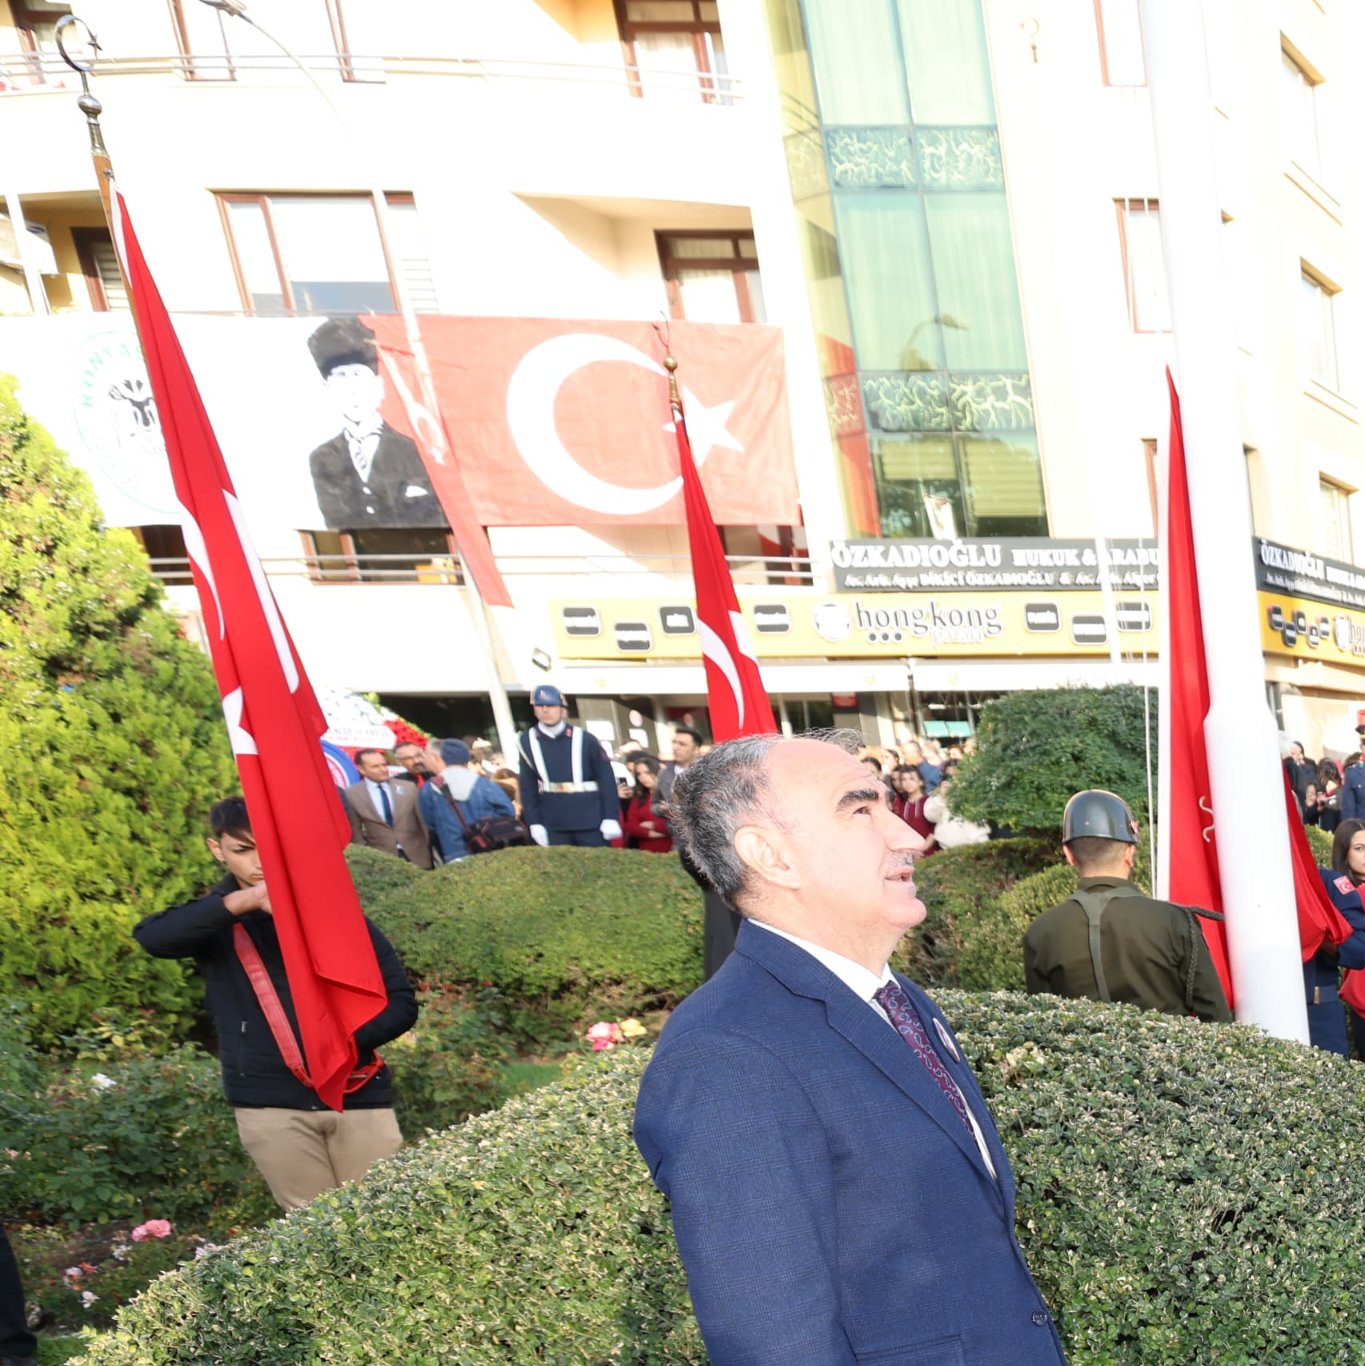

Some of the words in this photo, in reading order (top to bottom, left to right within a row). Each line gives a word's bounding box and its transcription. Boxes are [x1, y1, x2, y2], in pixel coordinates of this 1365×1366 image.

[831, 539, 1002, 568] ÖZKADIOĞLU
[1012, 549, 1081, 567] HUKUK
[855, 600, 1002, 636] hongkong
